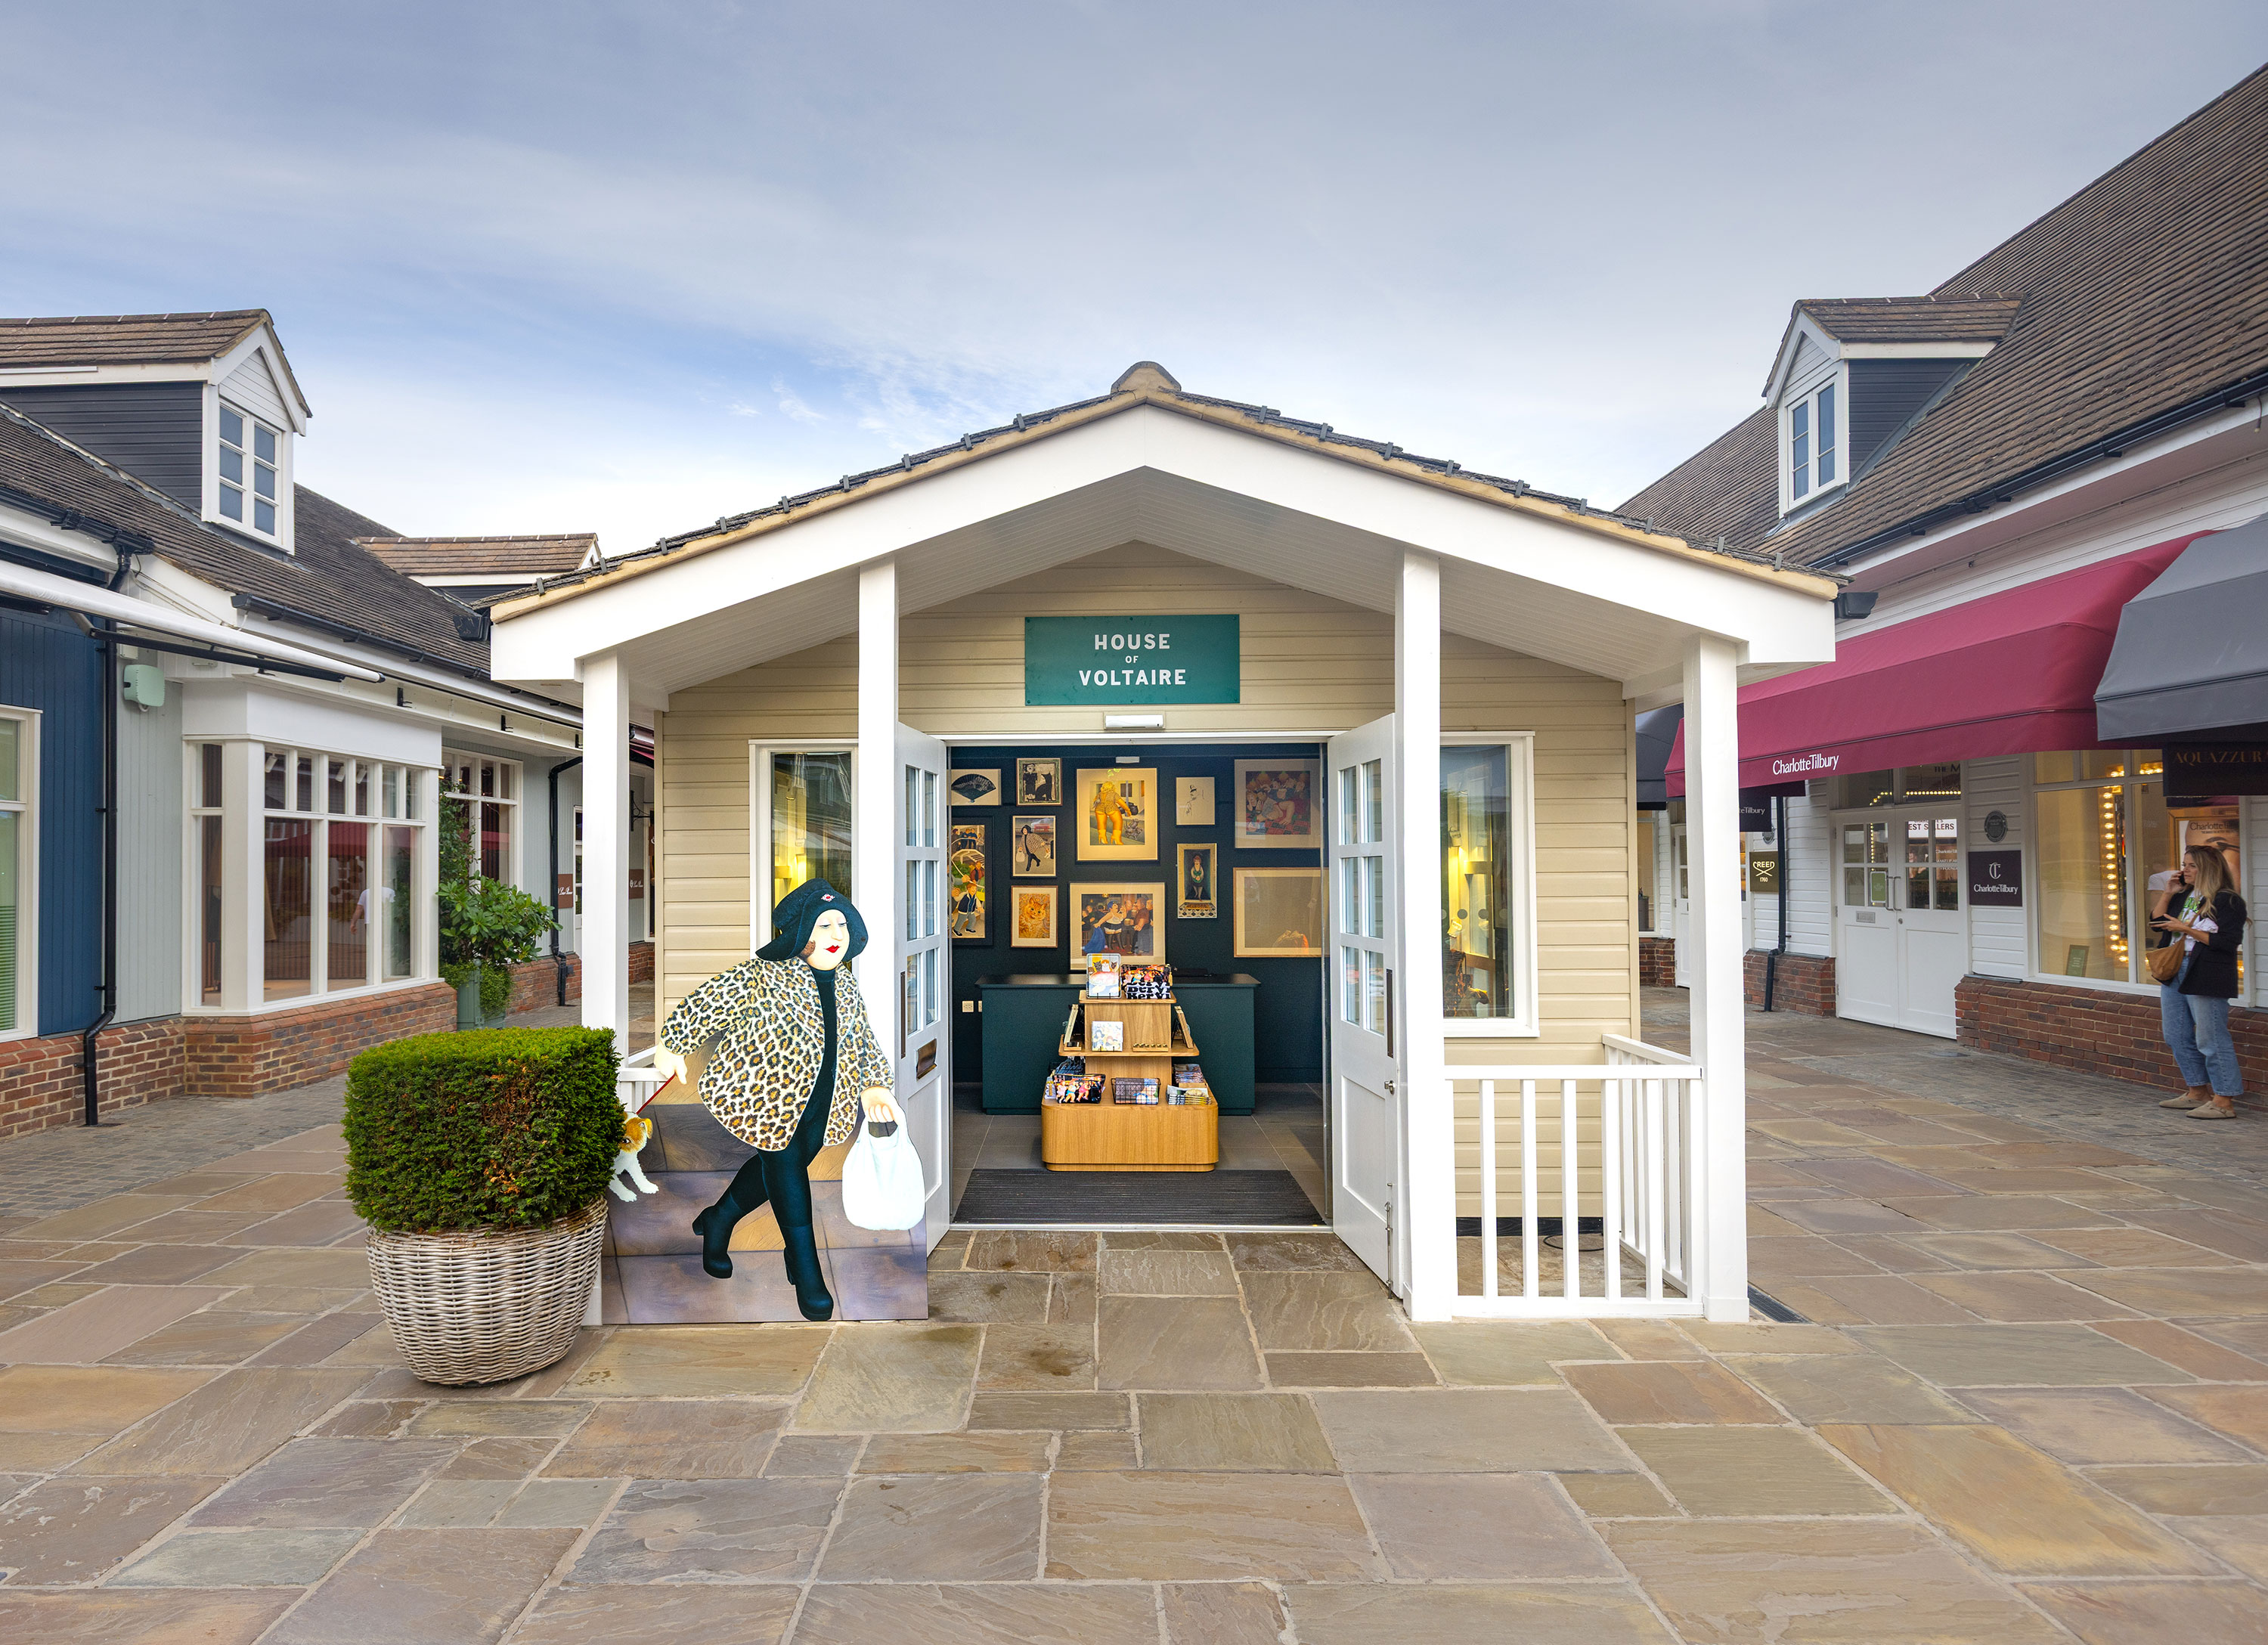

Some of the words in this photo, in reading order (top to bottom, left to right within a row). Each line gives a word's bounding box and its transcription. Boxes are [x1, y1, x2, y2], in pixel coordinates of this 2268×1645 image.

[1095, 634, 1170, 649] HOUSE
[1125, 655, 1139, 664] OF
[1079, 669, 1186, 686] VOLTAIRE
[1772, 753, 1839, 775] CharlotteTilbury
[2173, 751, 2268, 766] AQUAZZUR
[1752, 861, 1775, 869] CREED
[1973, 884, 2019, 895] CharlotteTilbury
